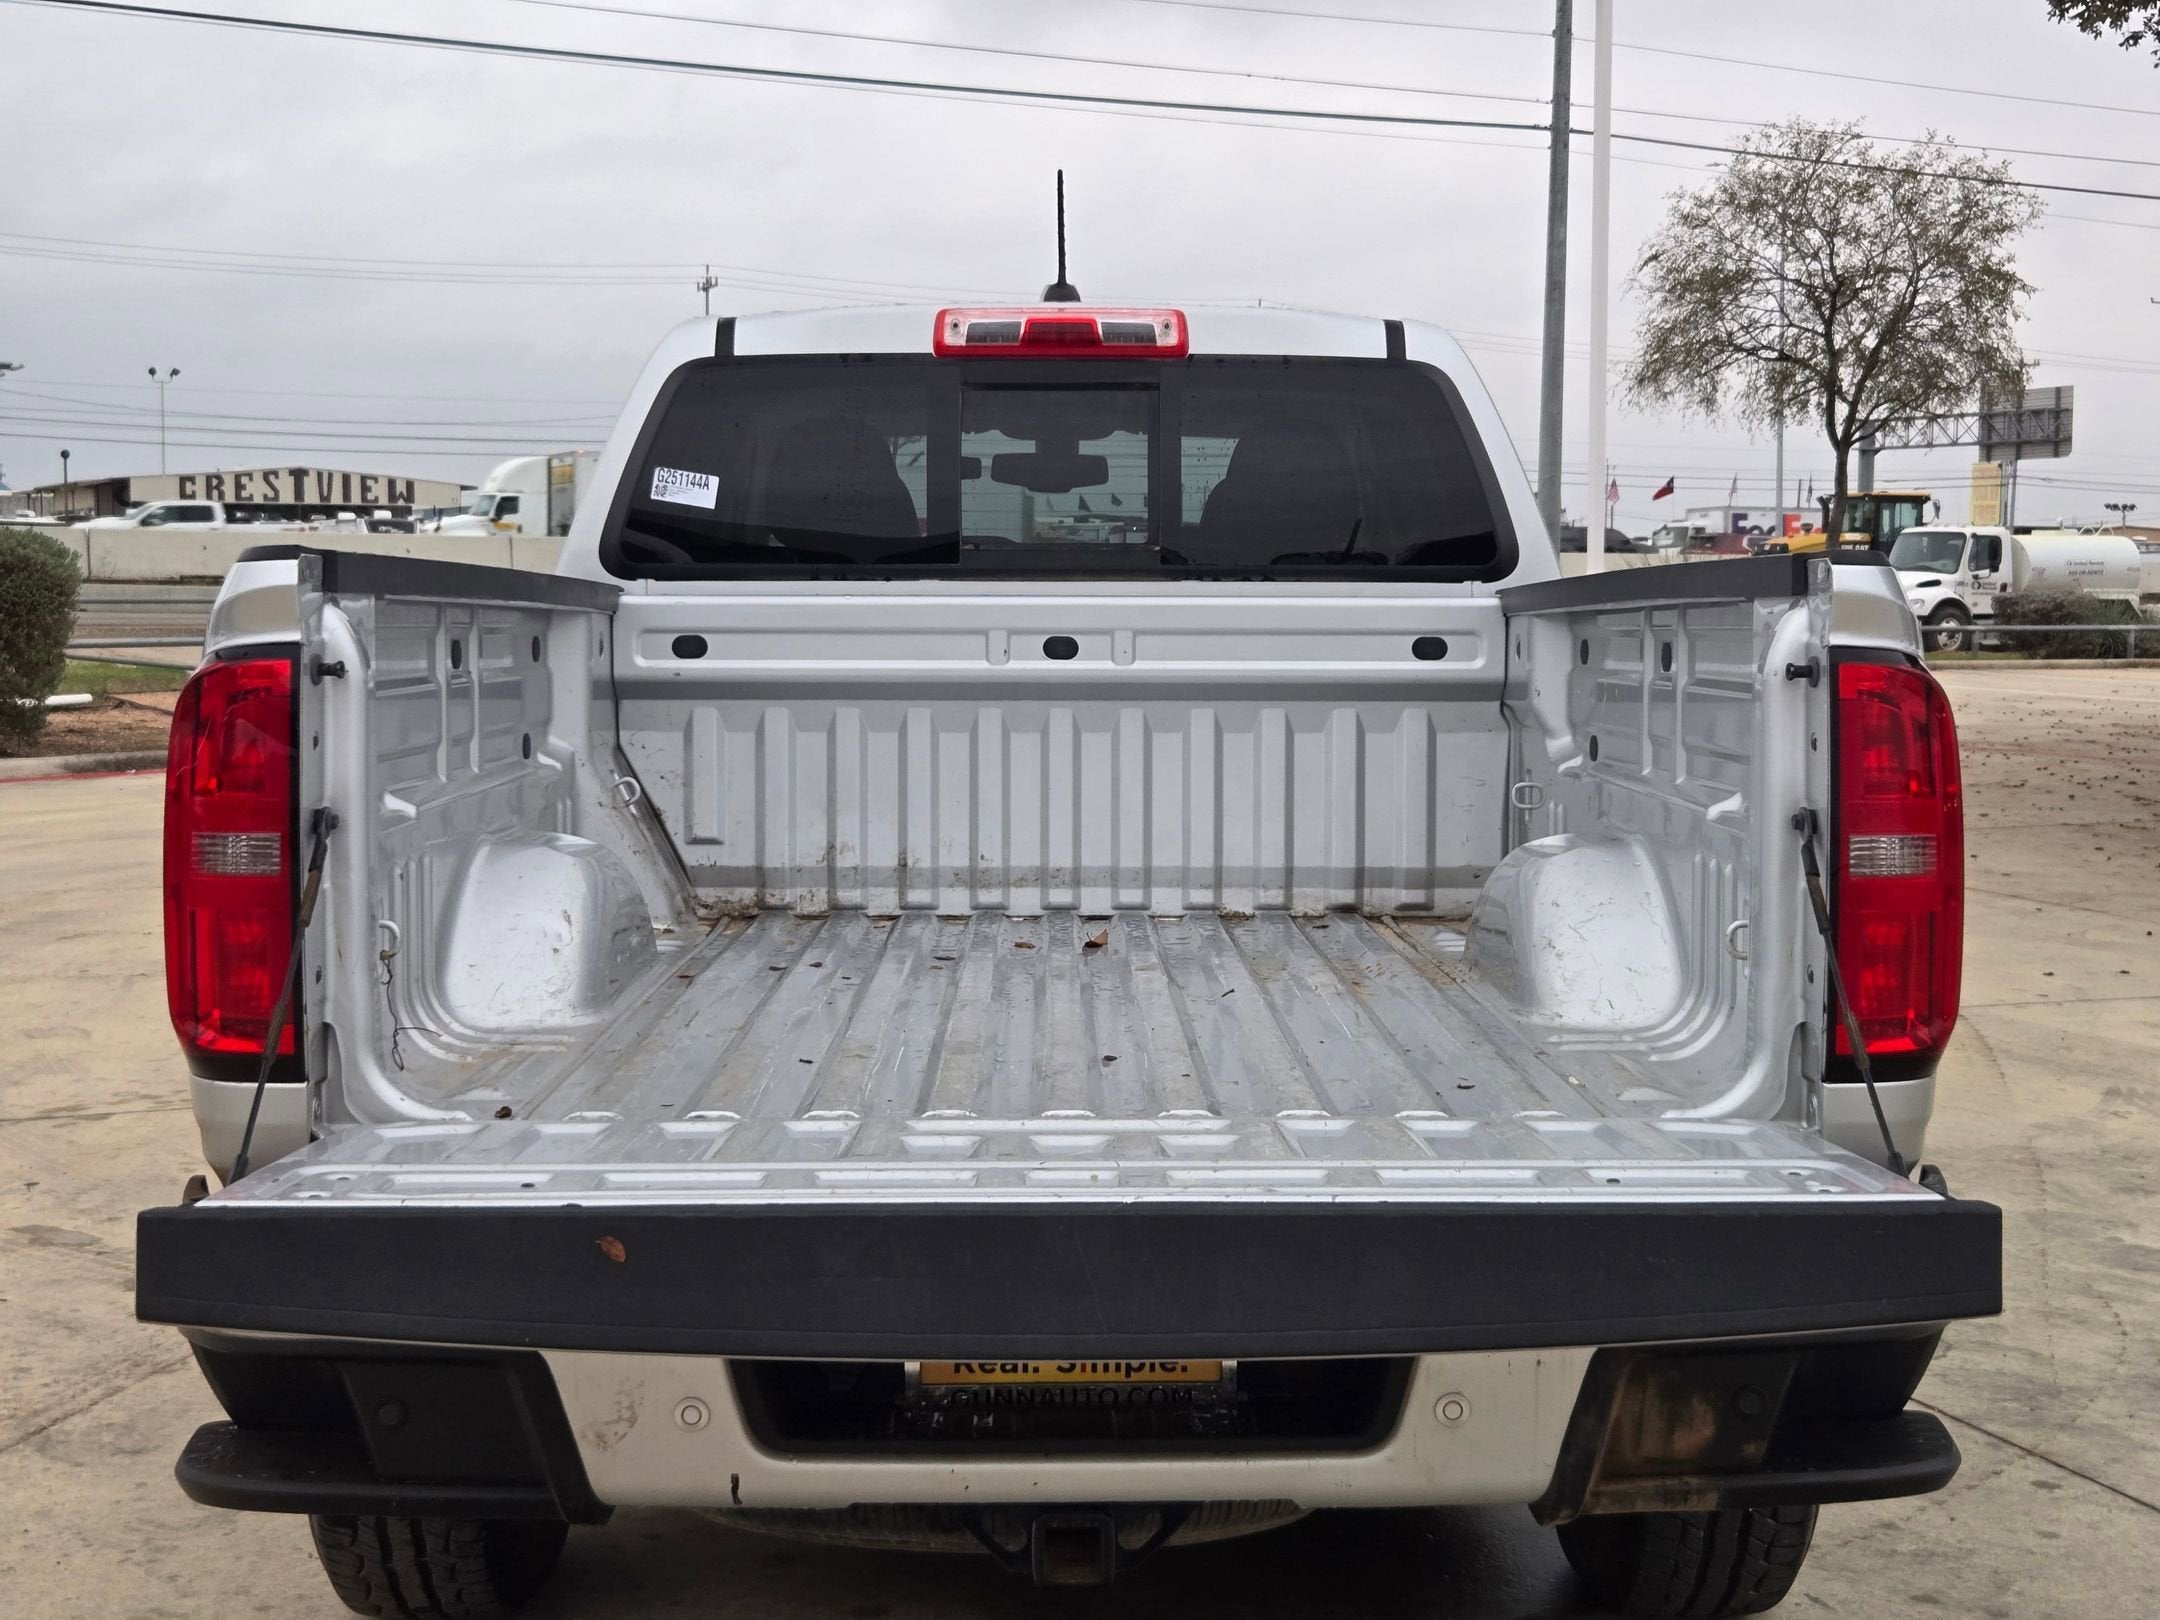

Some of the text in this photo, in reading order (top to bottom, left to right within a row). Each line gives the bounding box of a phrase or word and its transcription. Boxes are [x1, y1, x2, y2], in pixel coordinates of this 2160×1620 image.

[179, 468, 415, 504] CRESTVIEW
[657, 467, 710, 490] G251144A
[950, 1386, 1193, 1406] GUNNAUTOCOM
